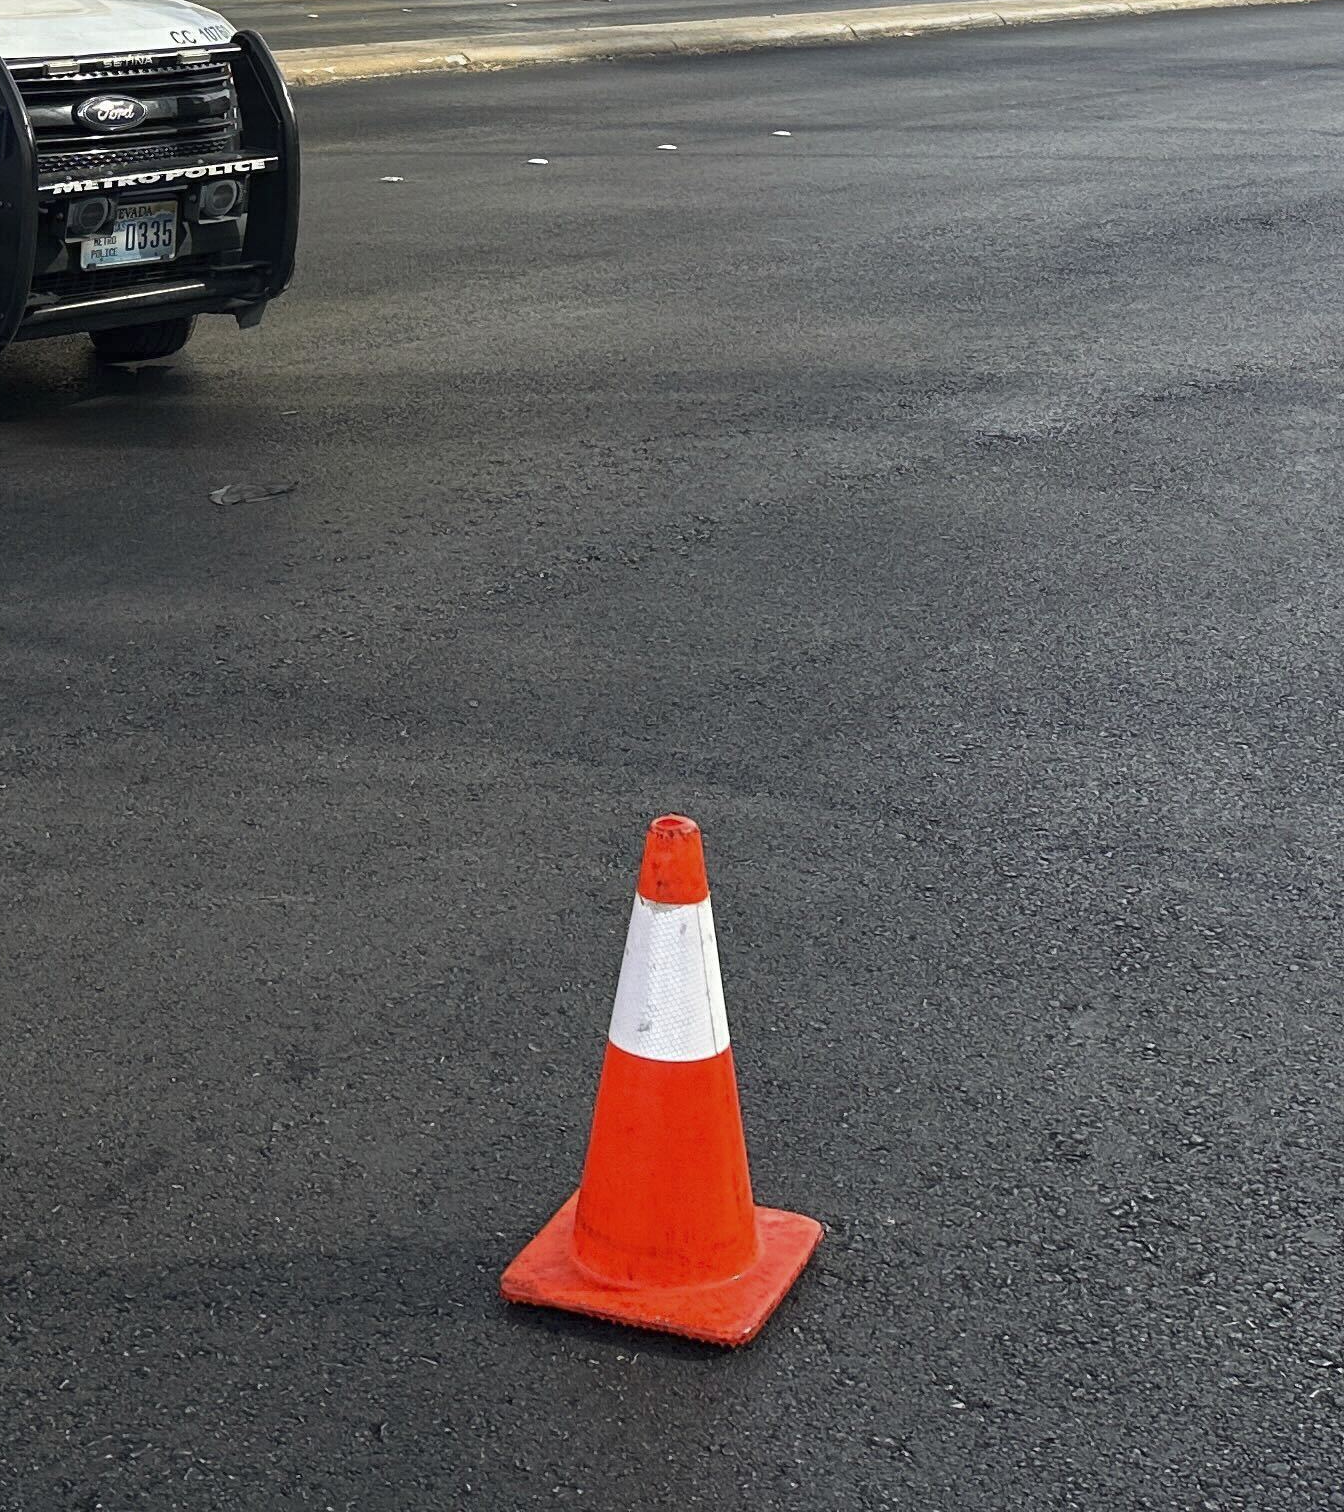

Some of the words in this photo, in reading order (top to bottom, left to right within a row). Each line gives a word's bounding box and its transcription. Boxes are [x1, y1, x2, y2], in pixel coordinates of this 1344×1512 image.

[169, 29, 197, 45] CC
[91, 99, 136, 122] Ford
[125, 218, 173, 252] 0335
